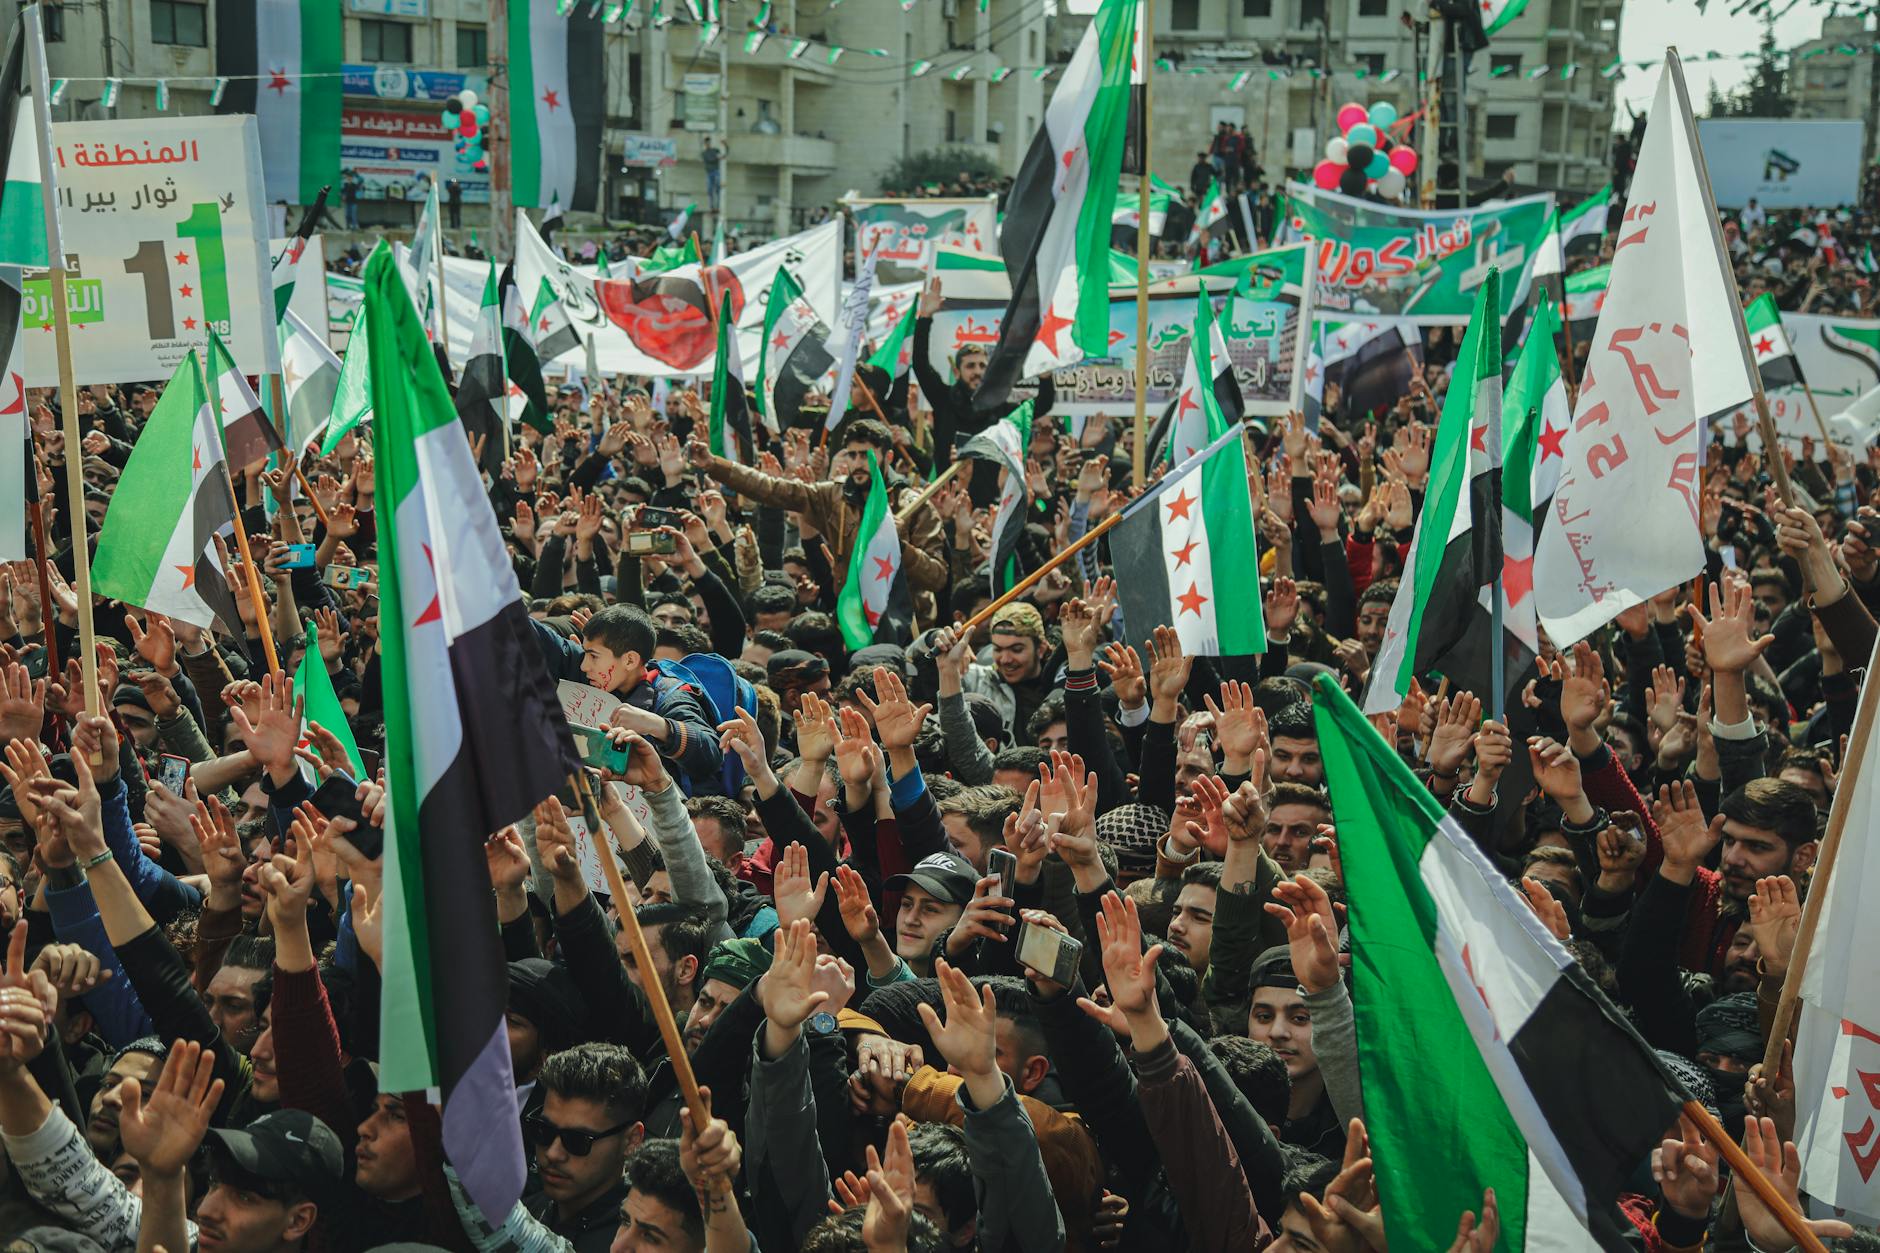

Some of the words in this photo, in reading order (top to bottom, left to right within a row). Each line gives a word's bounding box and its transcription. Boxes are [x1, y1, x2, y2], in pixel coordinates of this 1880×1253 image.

[74, 139, 199, 167] المنطقة
[81, 187, 116, 213] بير
[131, 176, 178, 211] ثوار
[1417, 218, 1472, 260] ثوار
[23, 284, 100, 322] الثرة
